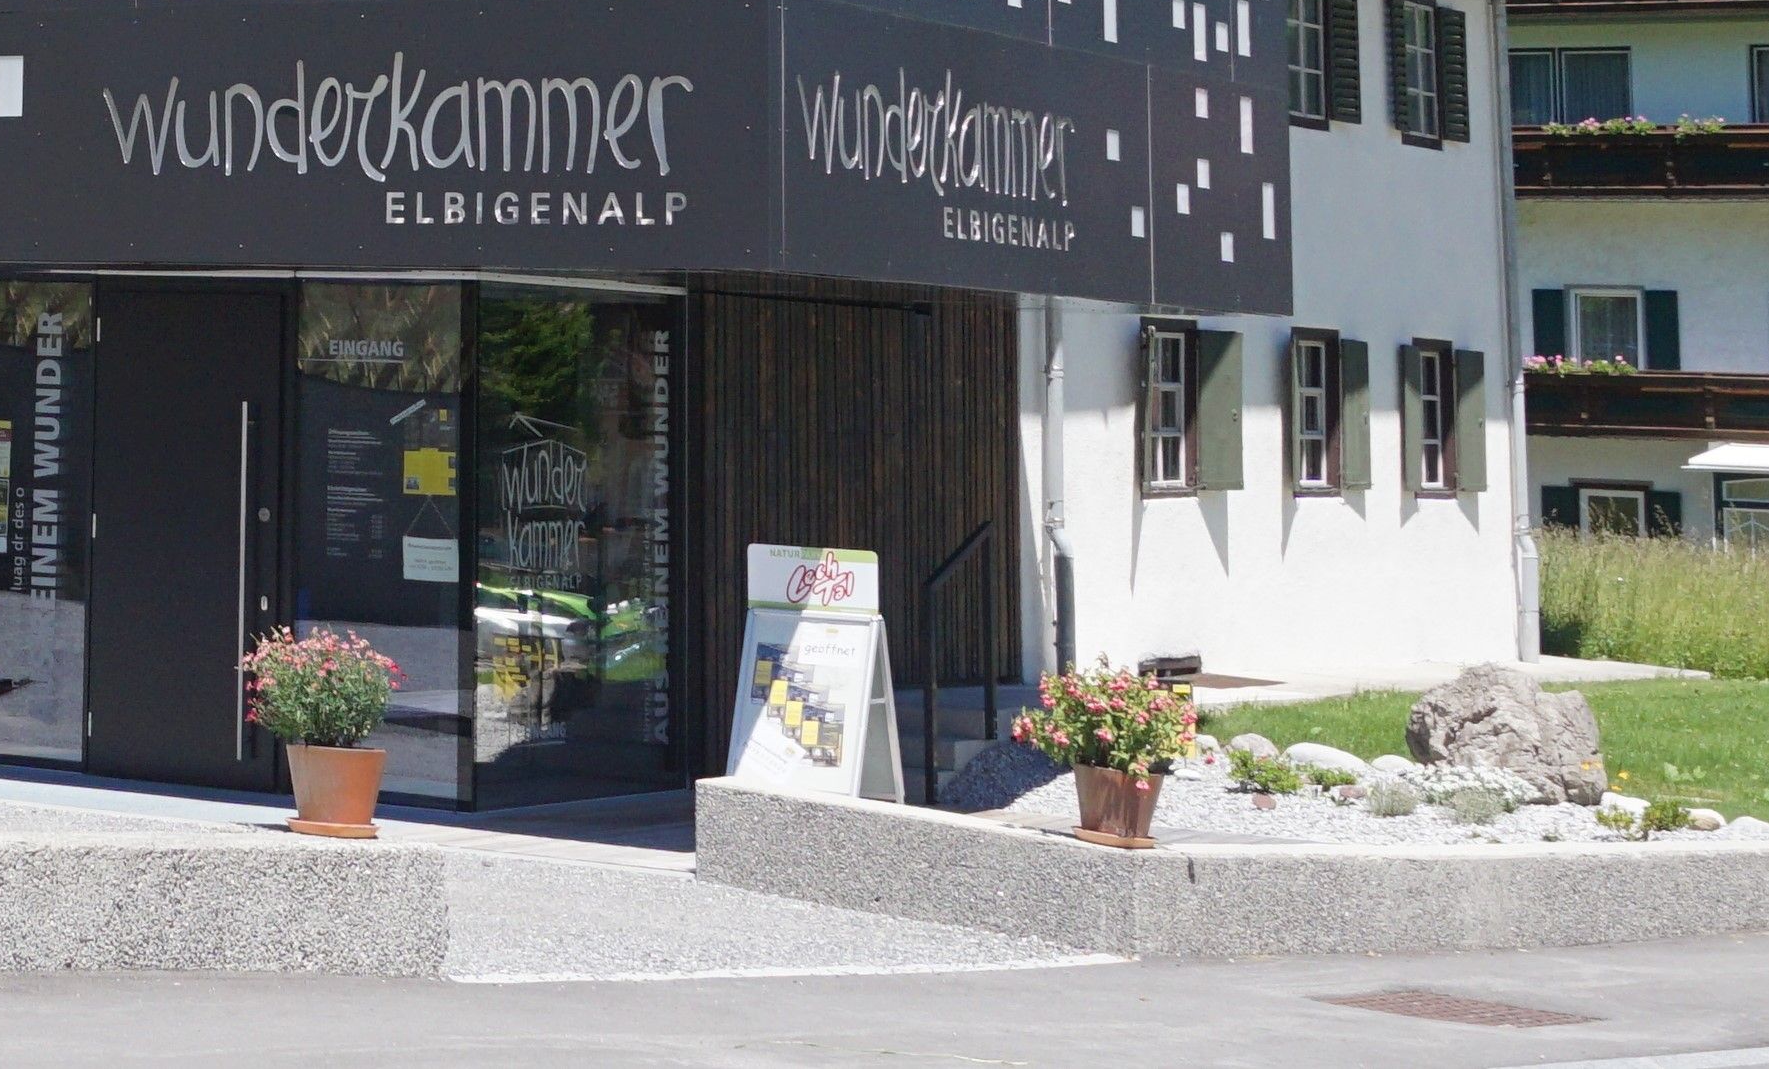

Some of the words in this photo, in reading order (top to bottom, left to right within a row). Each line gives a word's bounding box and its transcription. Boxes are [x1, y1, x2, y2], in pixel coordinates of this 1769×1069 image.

[102, 50, 694, 182] Wunderkammer
[796, 66, 1075, 207] Wunderkammer
[385, 191, 688, 226] ELBIGENALP
[943, 206, 1075, 252] ELBIGENALP
[328, 339, 404, 357] EINGANG
[33, 312, 63, 478] WUNDER
[654, 330, 670, 496] WUNDER
[15, 486, 25, 498] o
[12, 503, 25, 527] des
[11, 536, 24, 551] dr
[507, 509, 586, 573] kammer
[9, 556, 27, 591] luag
[787, 551, 839, 604] Lech
[812, 571, 855, 607] Tal
